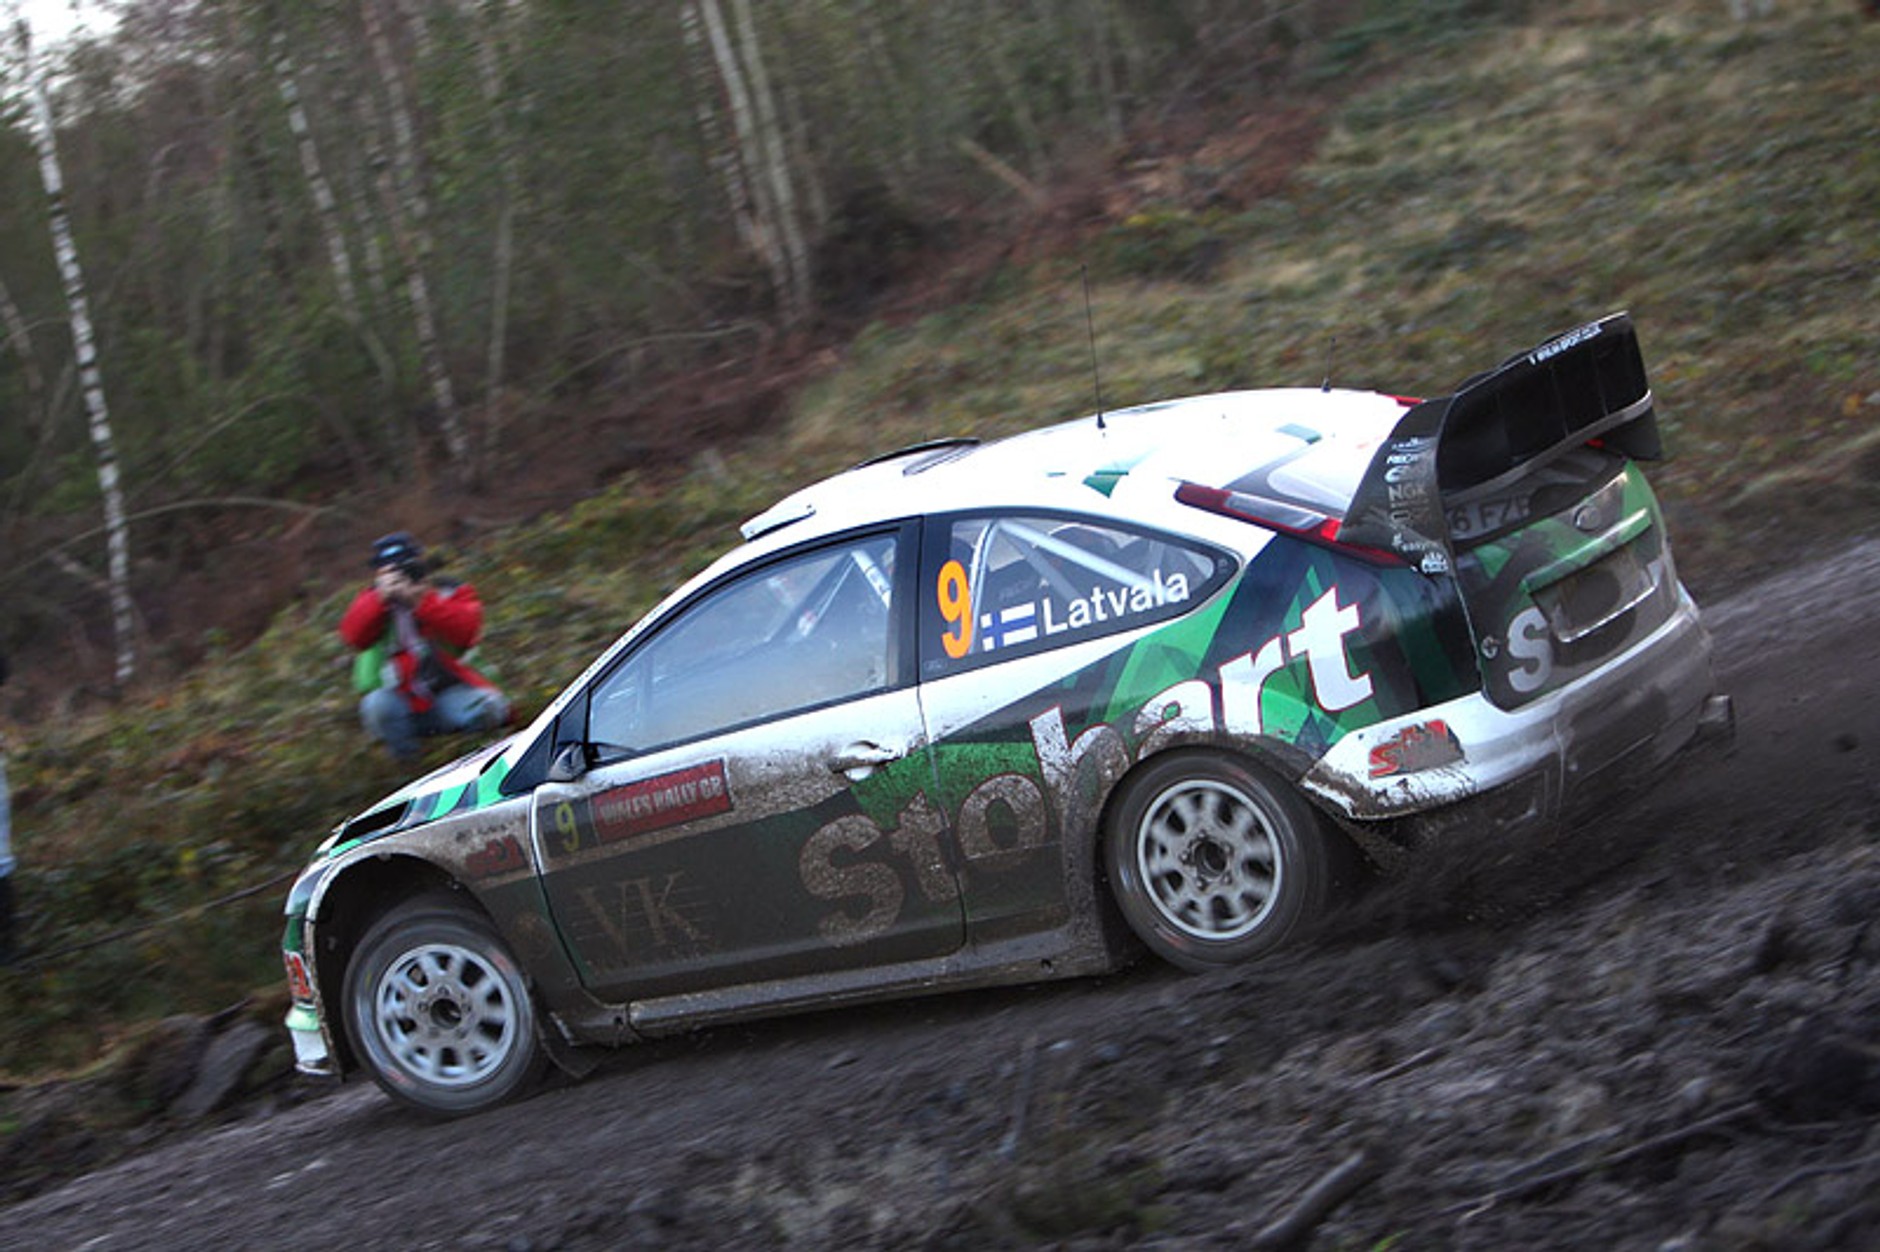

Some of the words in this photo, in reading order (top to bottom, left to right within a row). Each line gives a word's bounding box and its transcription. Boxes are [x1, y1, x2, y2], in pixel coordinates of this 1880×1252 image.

[937, 560, 974, 659] 9
[1042, 568, 1190, 635] Latvala
[554, 801, 580, 851] 9
[599, 792, 653, 826] WALES
[652, 780, 698, 811] RALLY
